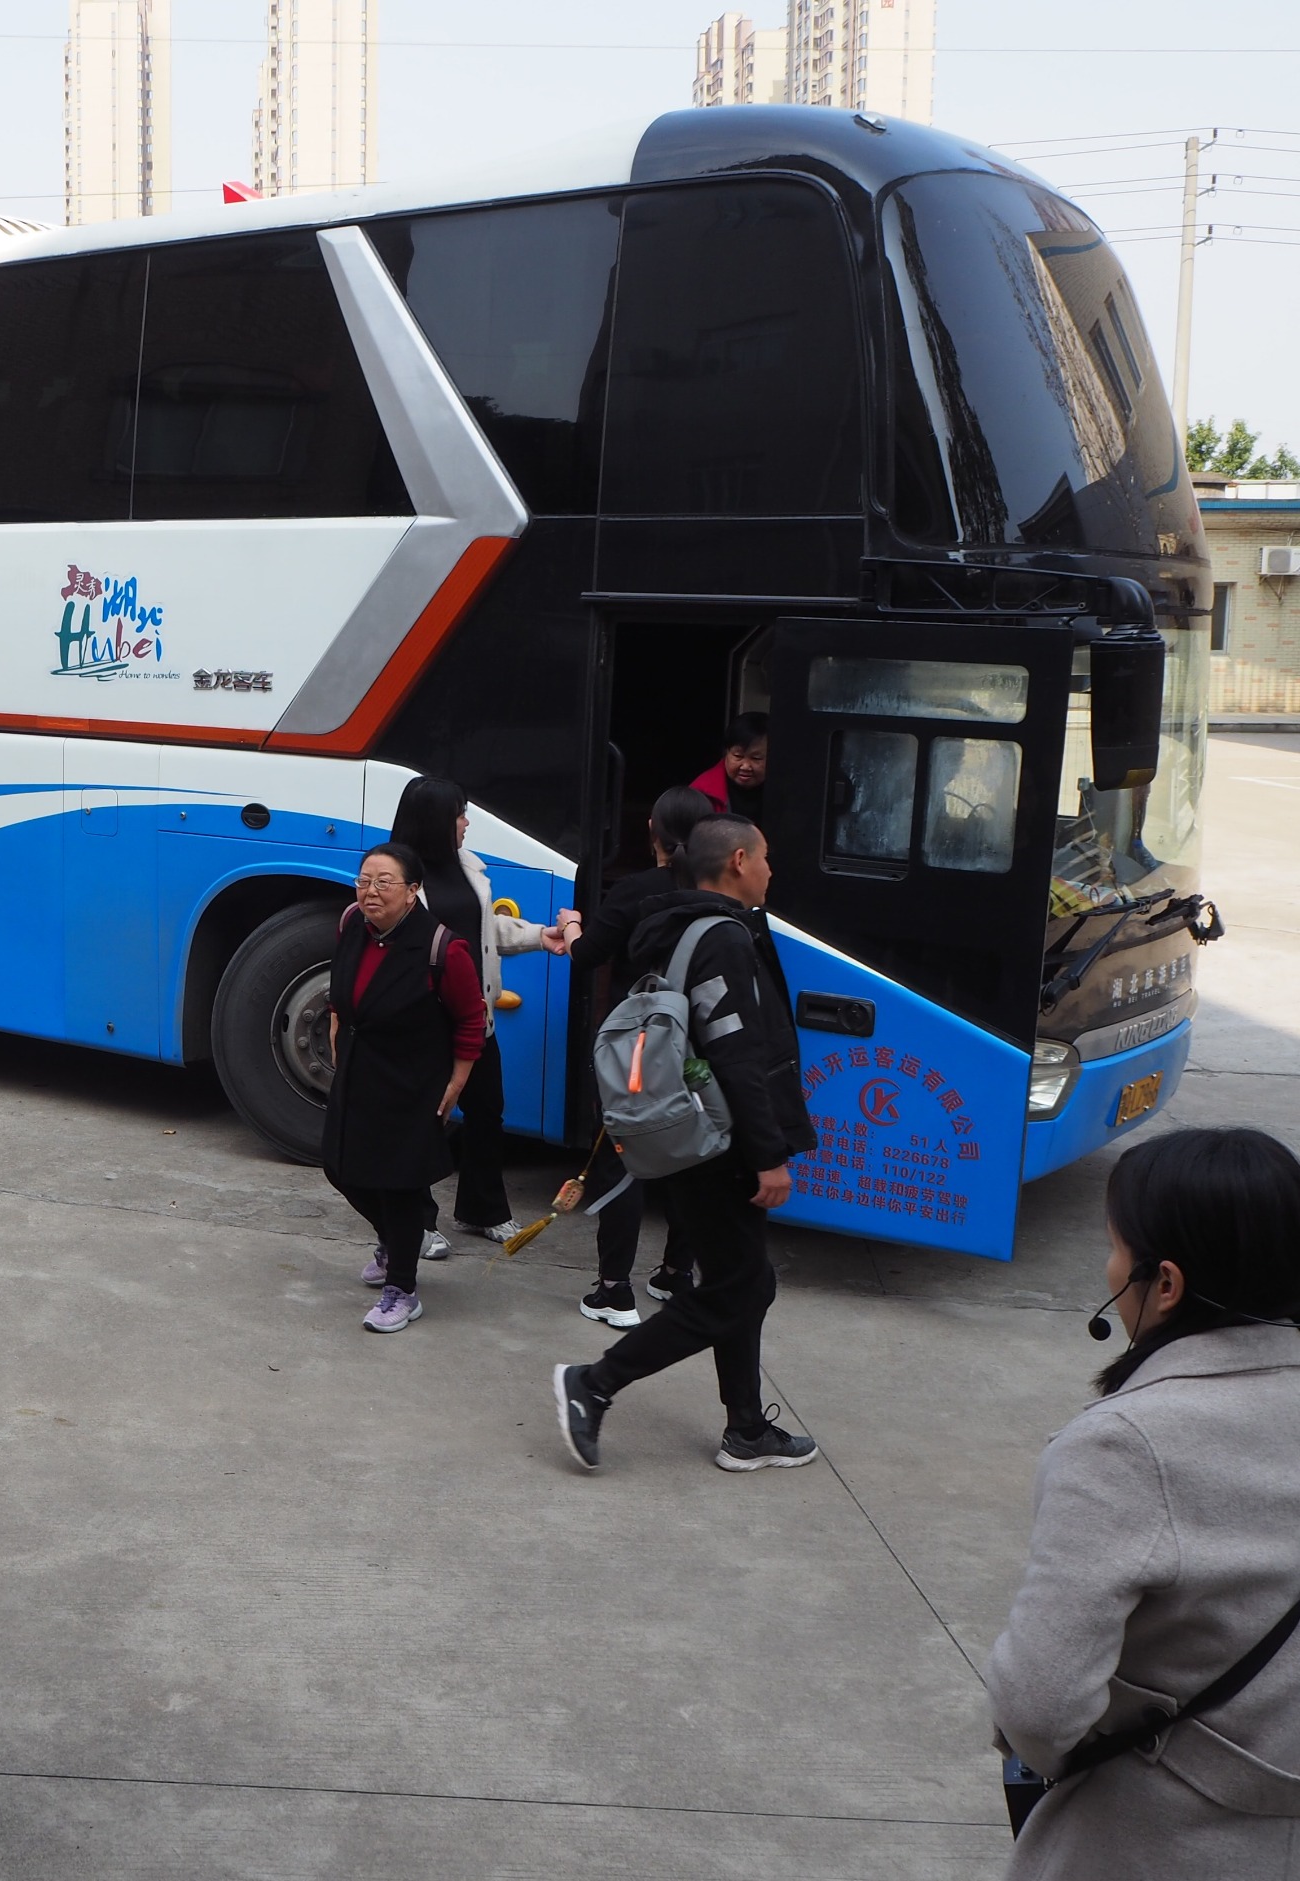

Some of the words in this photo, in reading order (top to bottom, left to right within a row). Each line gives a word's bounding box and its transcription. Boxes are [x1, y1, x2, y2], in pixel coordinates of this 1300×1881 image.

[102, 576, 163, 633] 湖北
[54, 601, 163, 670] Hubei
[192, 668, 273, 694] 金龙客车
[883, 1146, 950, 1169] 8226678
[883, 1163, 946, 1186] 110/122
[790, 1180, 966, 1226] 警在你身边伴你平安出行
